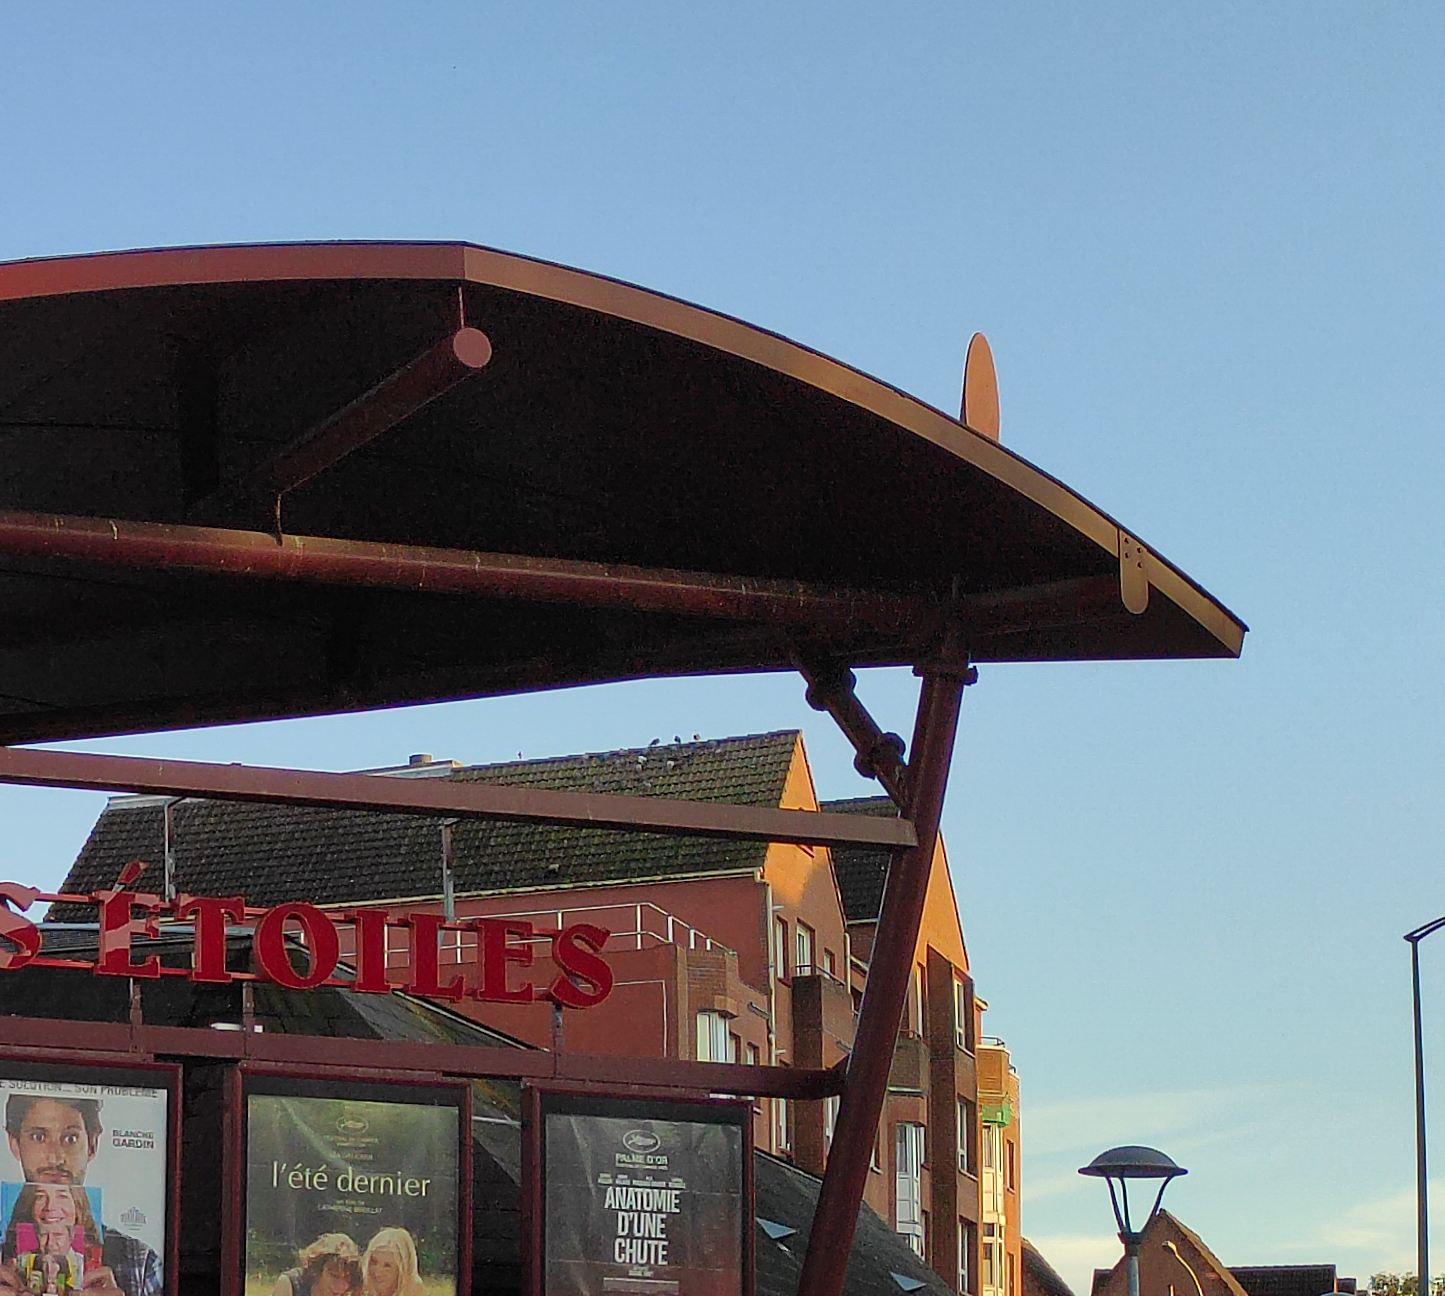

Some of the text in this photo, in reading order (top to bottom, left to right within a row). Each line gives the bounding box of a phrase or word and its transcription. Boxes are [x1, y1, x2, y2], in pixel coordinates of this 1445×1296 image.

[93, 861, 615, 1010] ÉTOILES
[112, 1129, 154, 1140] BLANCHE
[616, 1153, 645, 1165] PALME
[272, 1160, 431, 1197] l'été dernier
[604, 1187, 680, 1213] ANATOMIE
[617, 1211, 667, 1239] D'UNE
[615, 1238, 669, 1266] CHUTE
